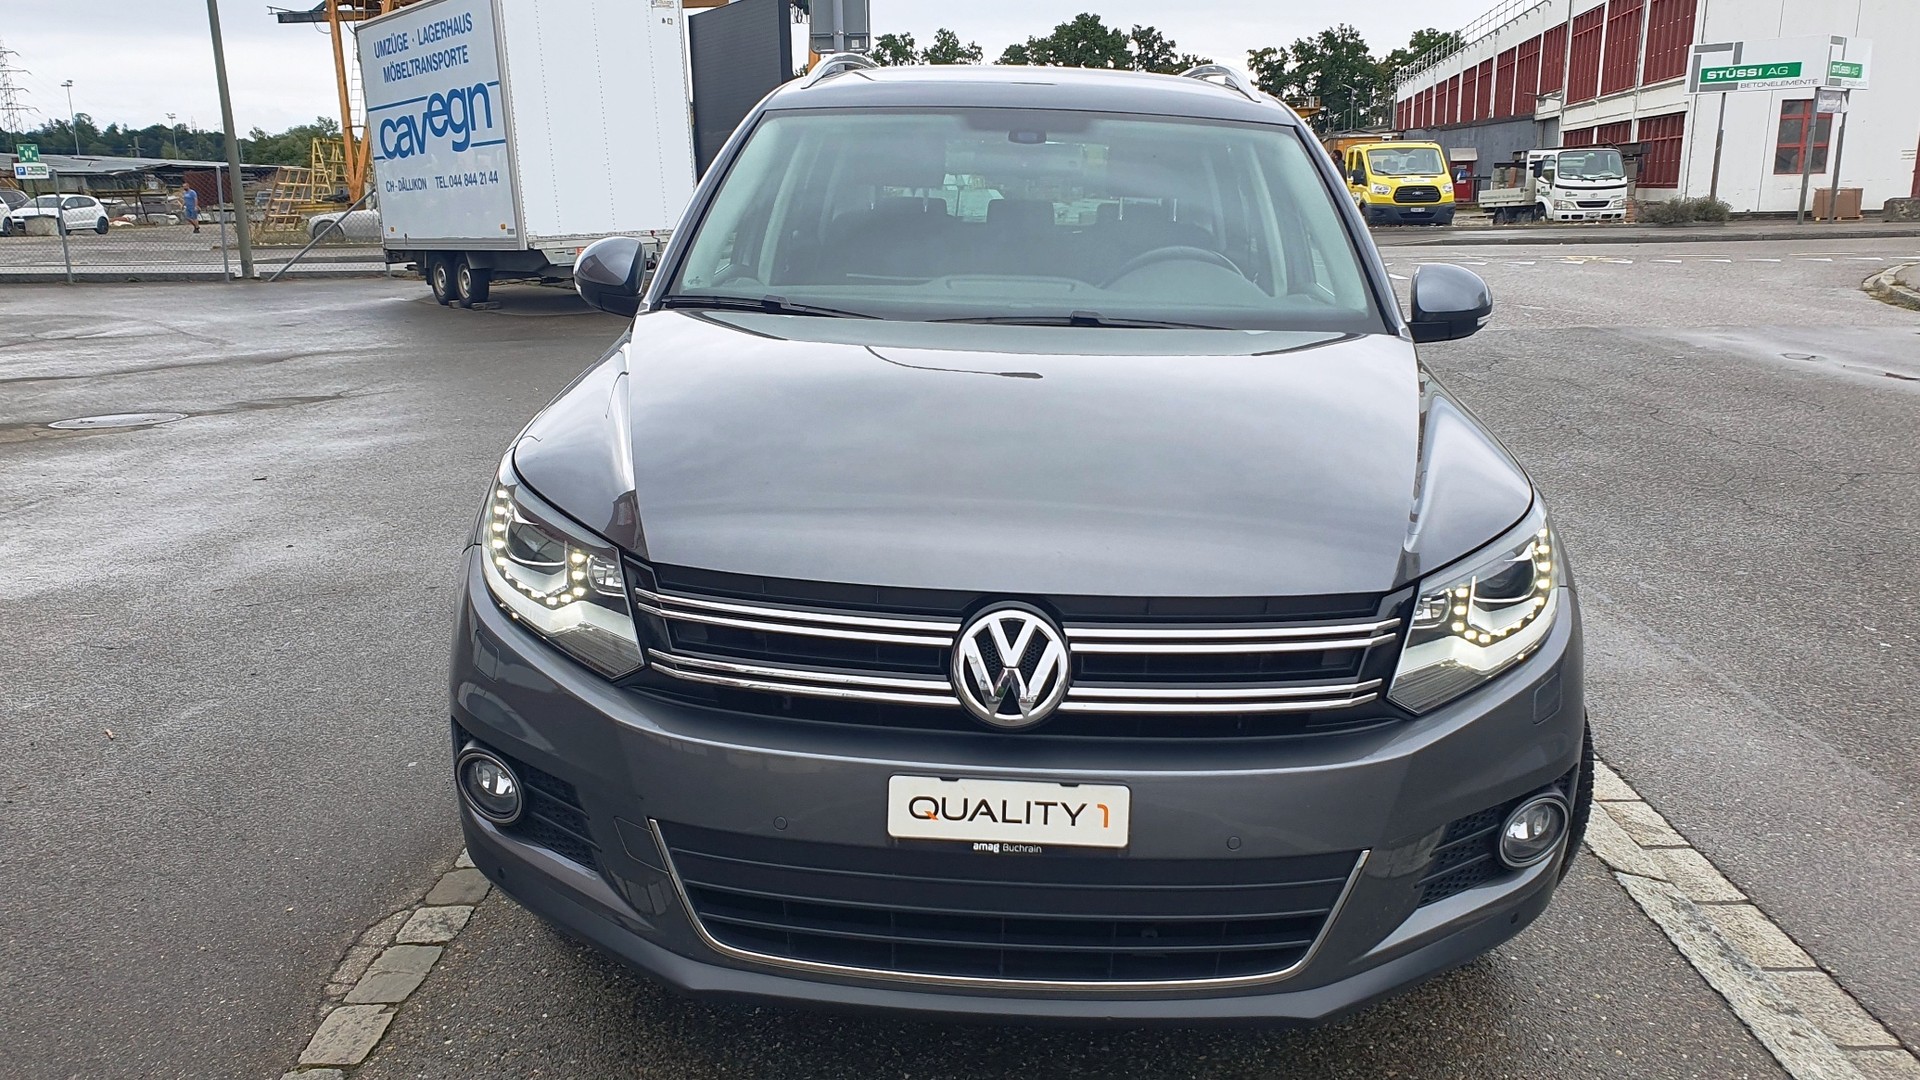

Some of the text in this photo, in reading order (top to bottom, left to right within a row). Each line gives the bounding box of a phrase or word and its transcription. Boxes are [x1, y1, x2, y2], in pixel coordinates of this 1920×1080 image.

[373, 12, 472, 58] UMZÜGE LAGERHAUS
[383, 45, 468, 83] MÖBELTRANSPORTE
[1707, 66, 1789, 80] STÜSSI AG
[1740, 78, 1818, 89] BETONELEMENTE
[380, 82, 492, 160] cavegn
[464, 172, 477, 187] 844
[479, 171, 487, 185] 21
[489, 170, 499, 184] 44
[973, 842, 1042, 853] amag Buchrain
